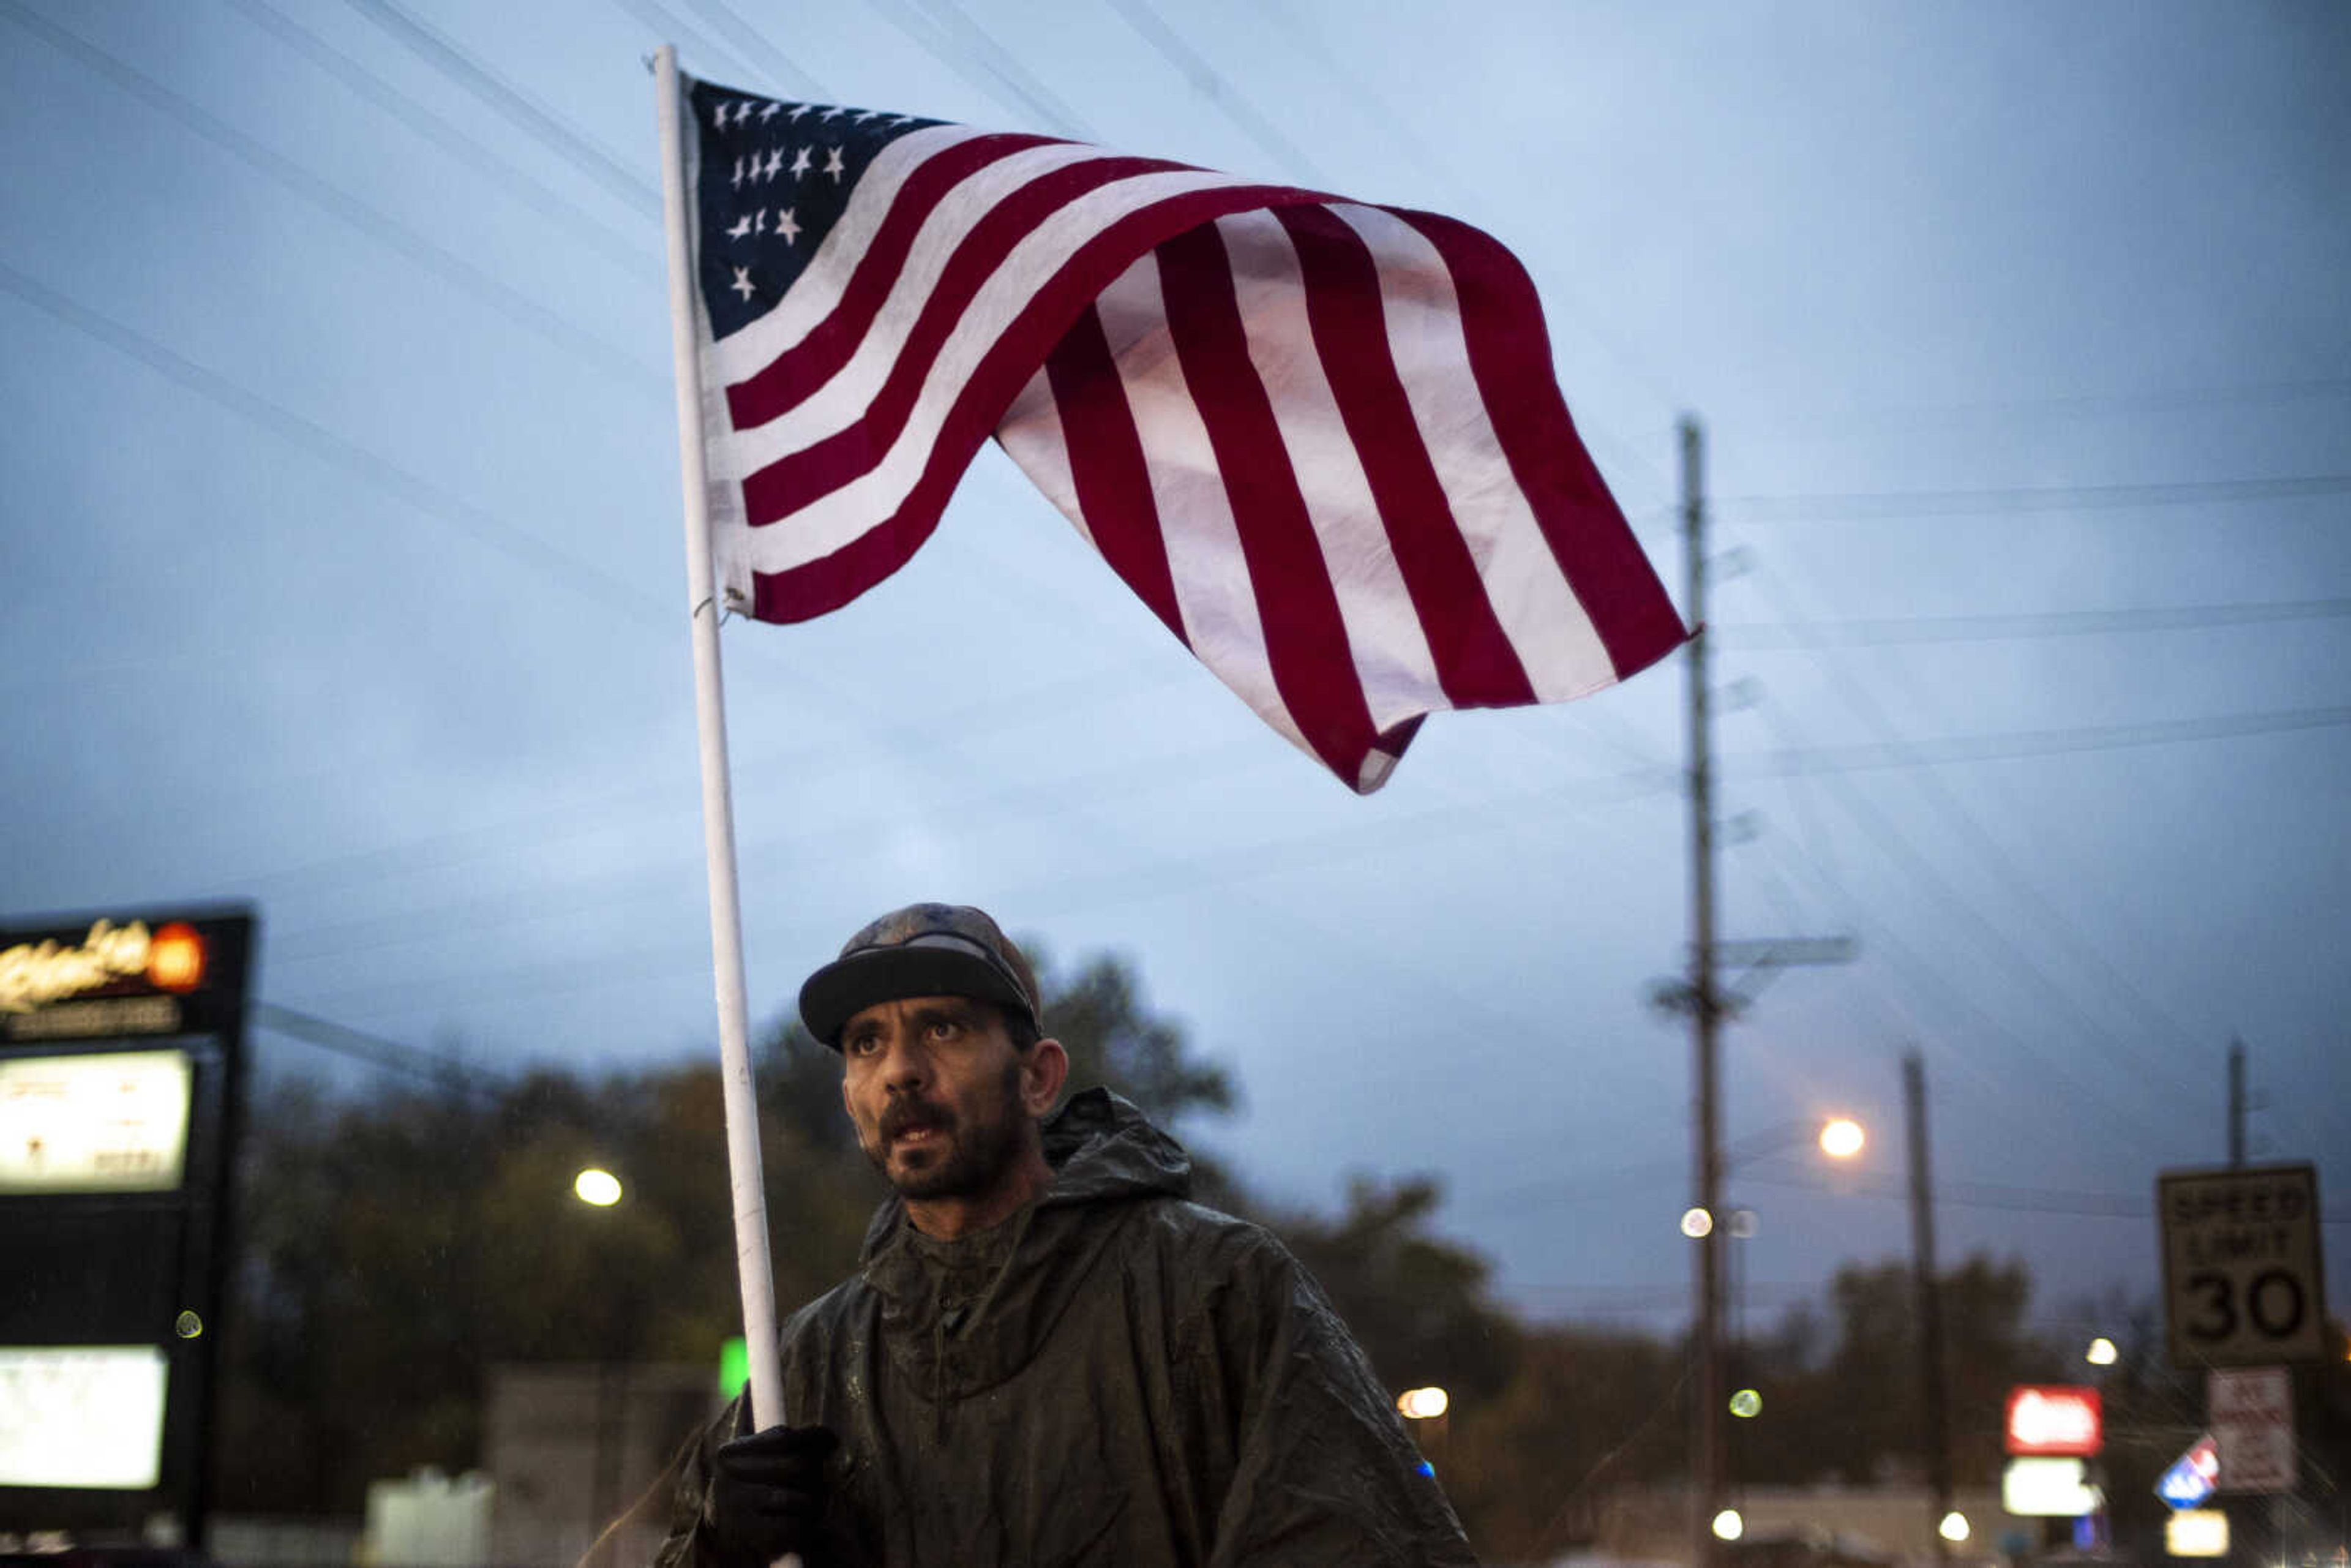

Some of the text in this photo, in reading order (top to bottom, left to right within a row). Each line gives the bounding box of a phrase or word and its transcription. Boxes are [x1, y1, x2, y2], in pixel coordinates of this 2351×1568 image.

[2174, 1186, 2306, 1224] SPEED
[2186, 1226, 2292, 1266] LIMIT
[2186, 1267, 2306, 1345] 30
